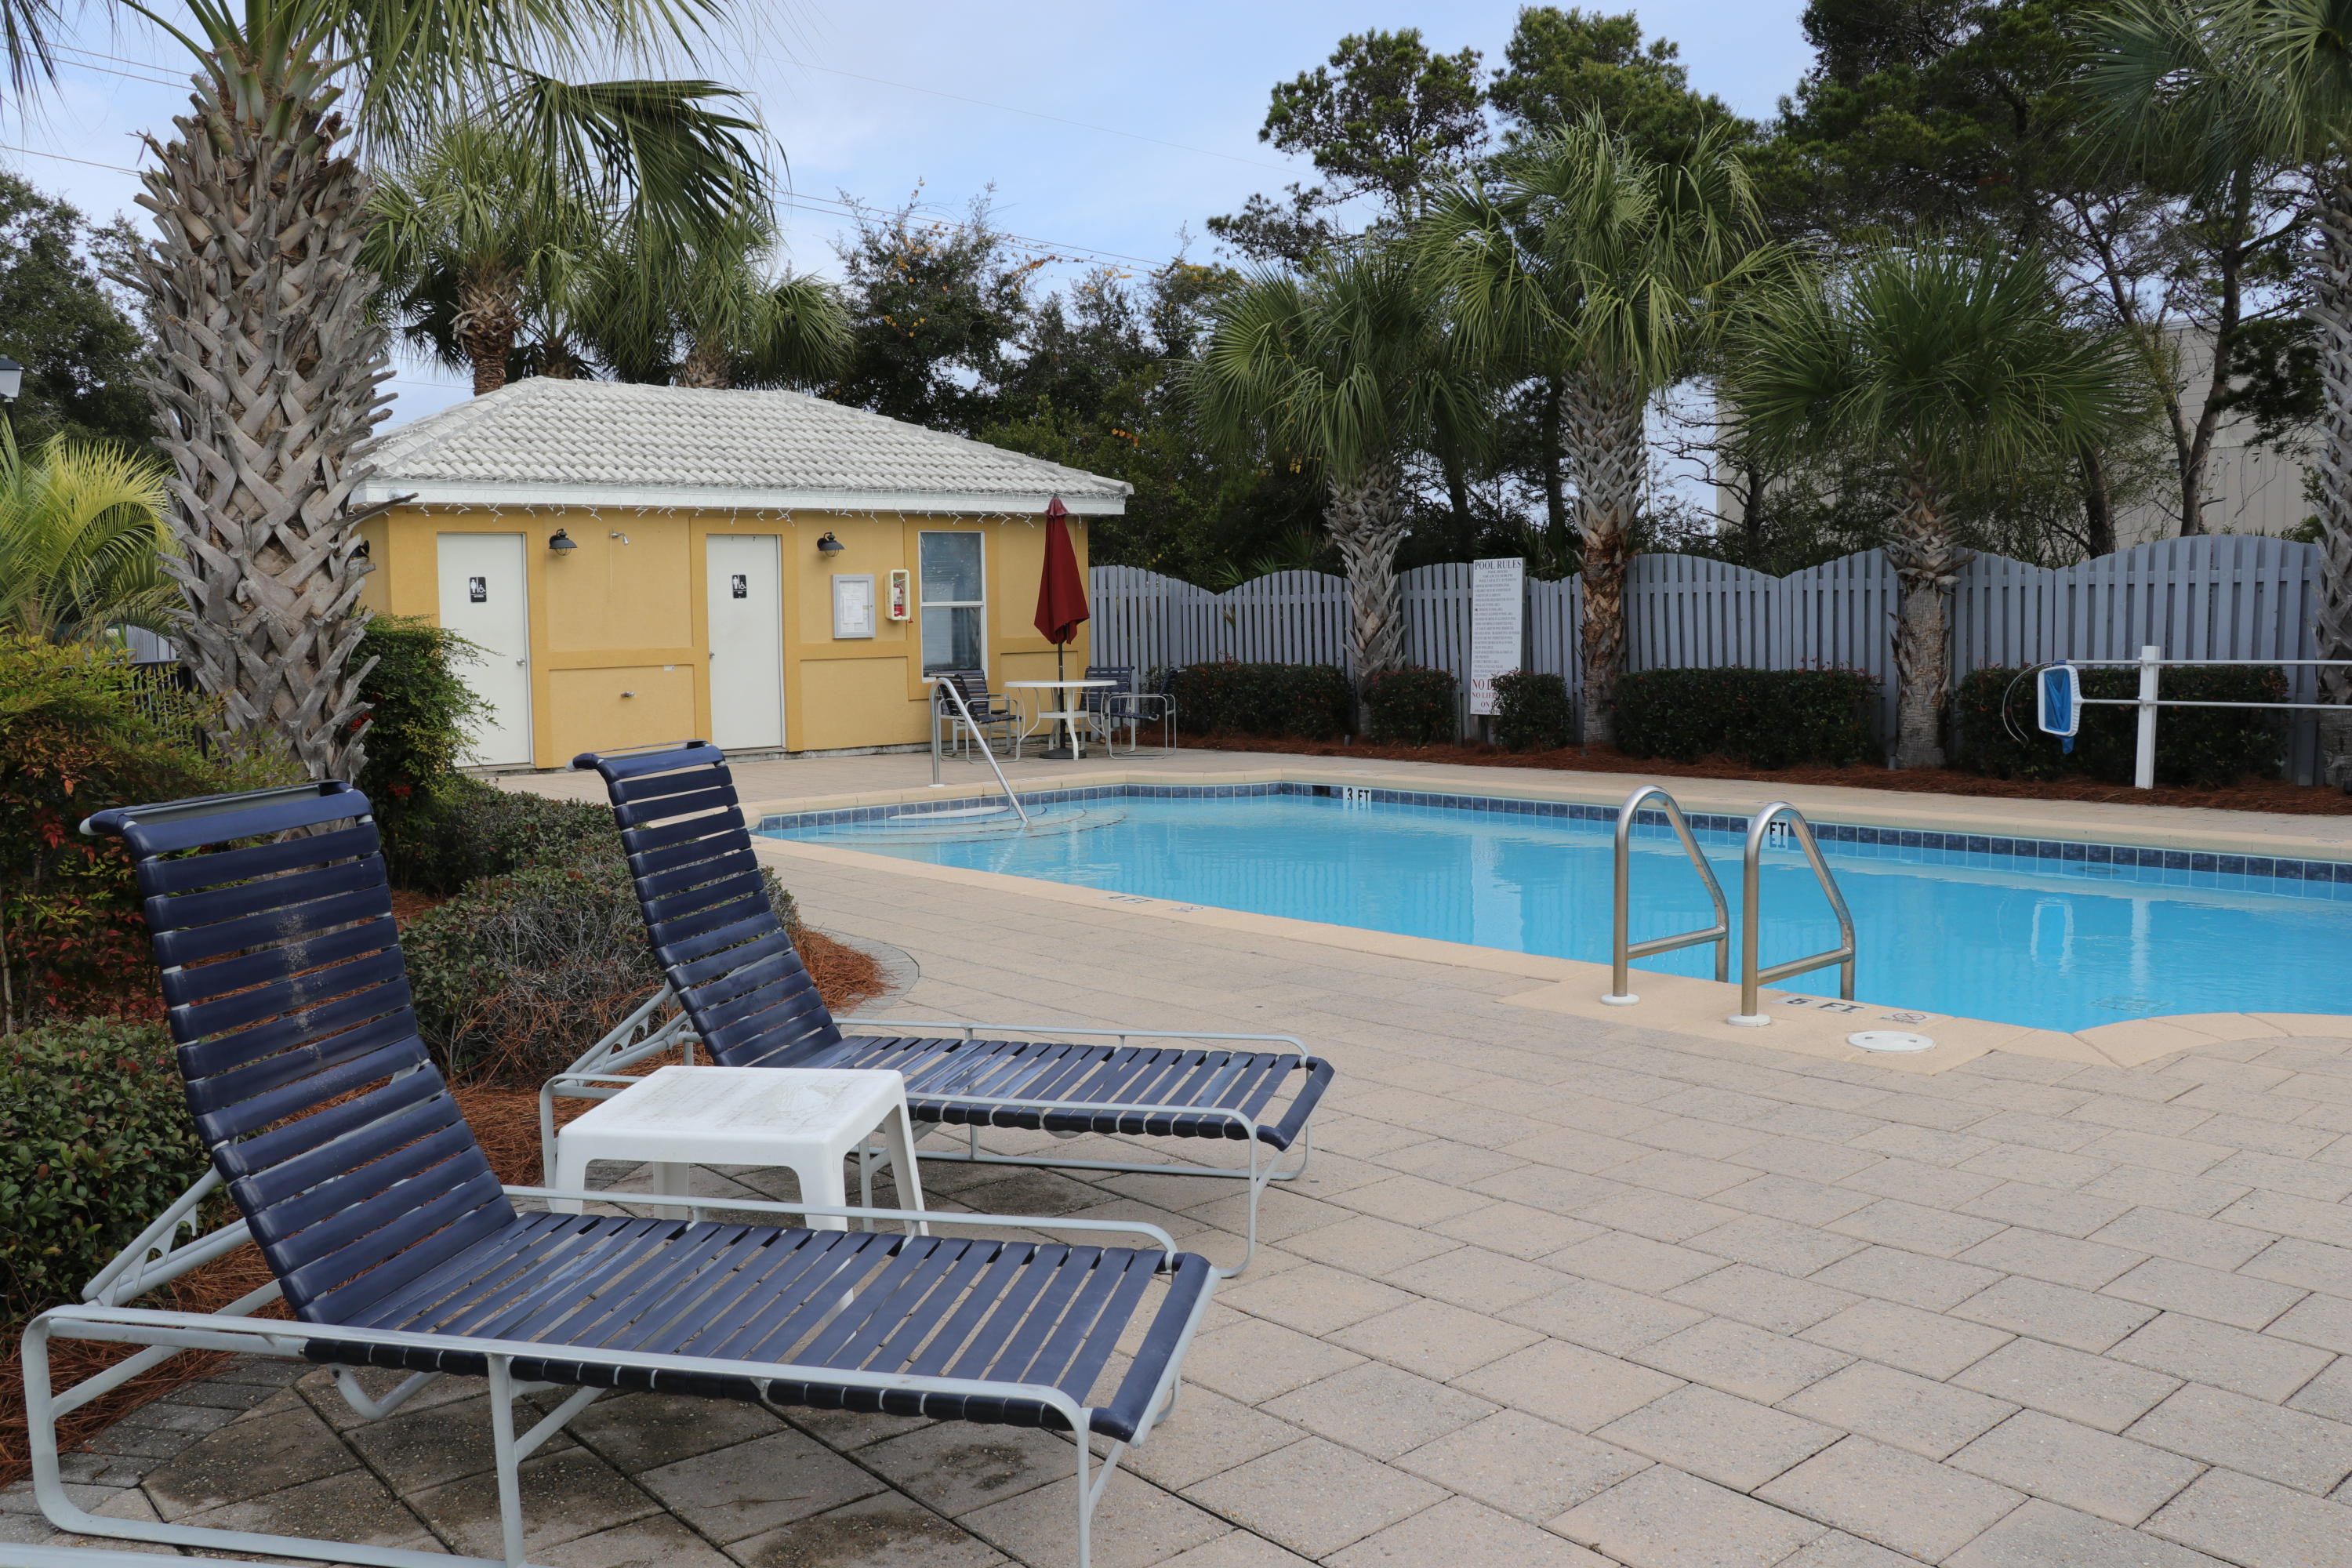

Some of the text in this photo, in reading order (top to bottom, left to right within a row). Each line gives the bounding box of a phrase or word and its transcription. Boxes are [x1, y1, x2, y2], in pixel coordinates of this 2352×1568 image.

[1475, 560, 1521, 570] POOL RULES
[1472, 678, 1485, 690] NO
[1347, 787, 1370, 801] 3 FT
[1769, 822, 1786, 836] FT
[1817, 1002, 1864, 1013] FT
